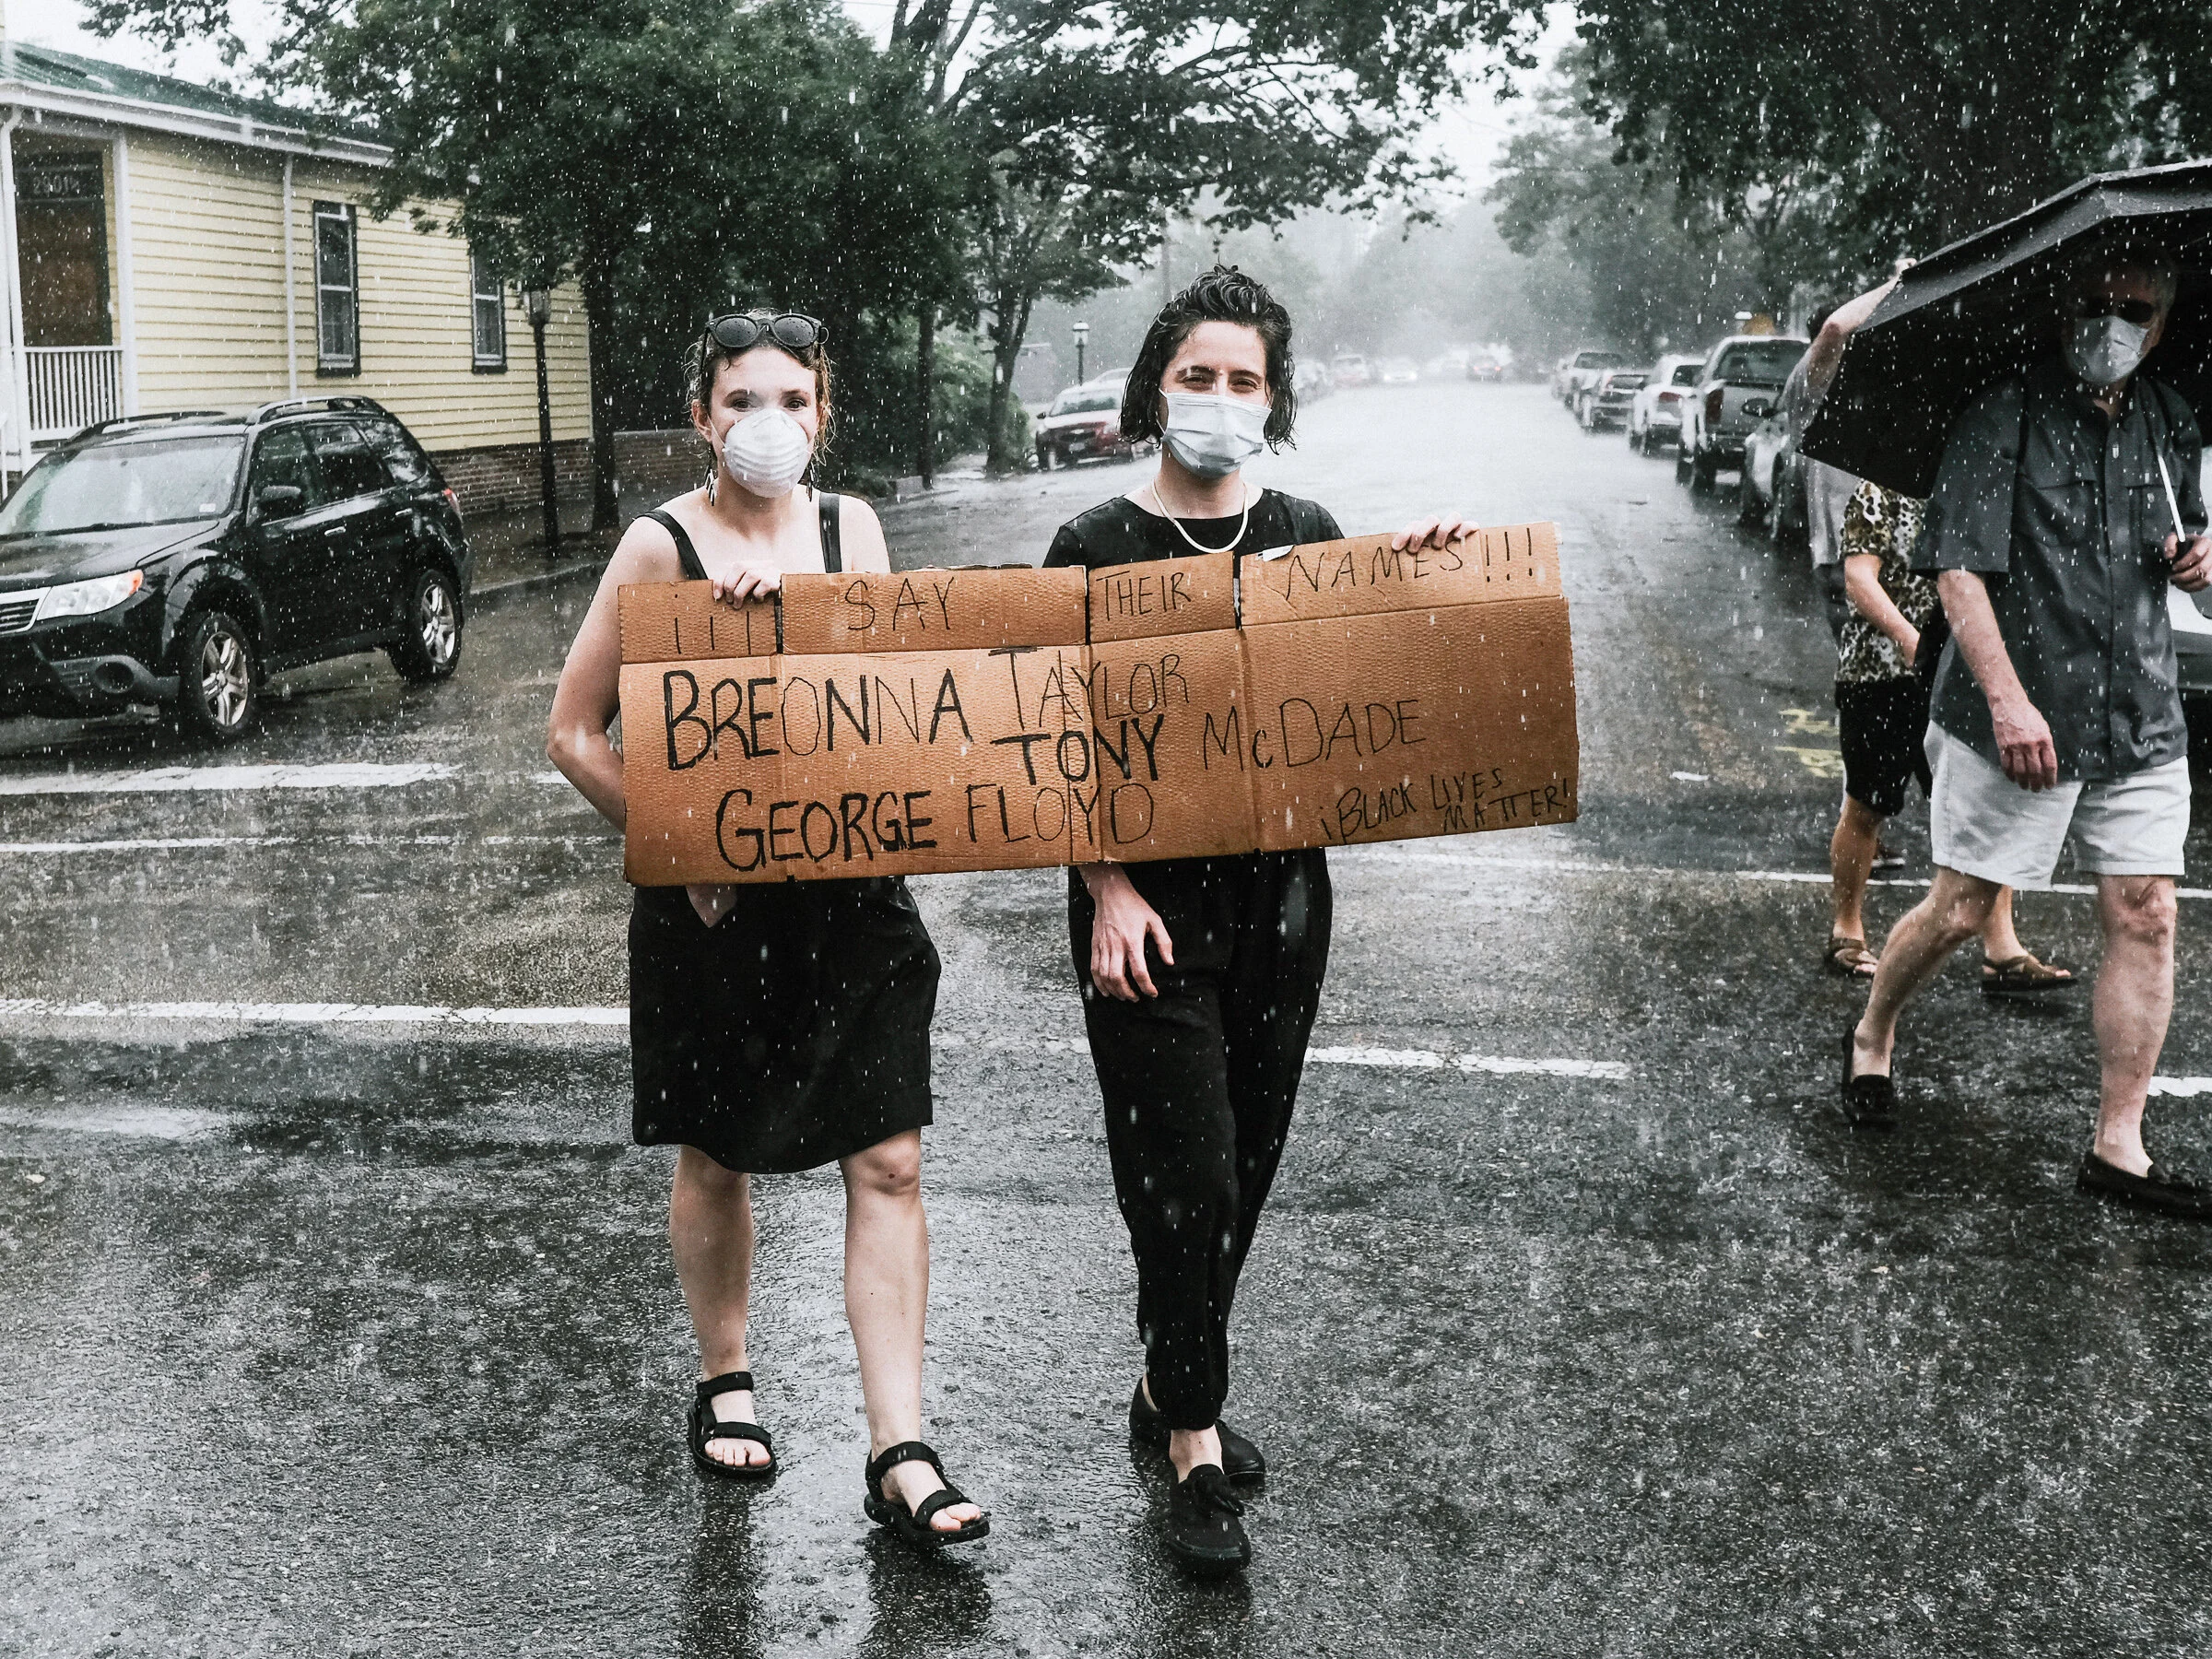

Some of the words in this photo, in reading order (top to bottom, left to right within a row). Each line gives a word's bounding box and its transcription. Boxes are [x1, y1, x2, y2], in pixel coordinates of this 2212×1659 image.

[843, 576, 955, 631] SAY
[1095, 569, 1193, 622] THEIR
[663, 668, 972, 771] BREONNA
[988, 646, 1190, 731] TAYLOR
[990, 713, 1165, 786] TONY
[1203, 698, 1427, 771] McDADE
[1430, 767, 1503, 811] LIVES
[1442, 778, 1569, 833] MATTER!
[714, 788, 938, 873] GEORGE
[964, 782, 1155, 847] FLOYD
